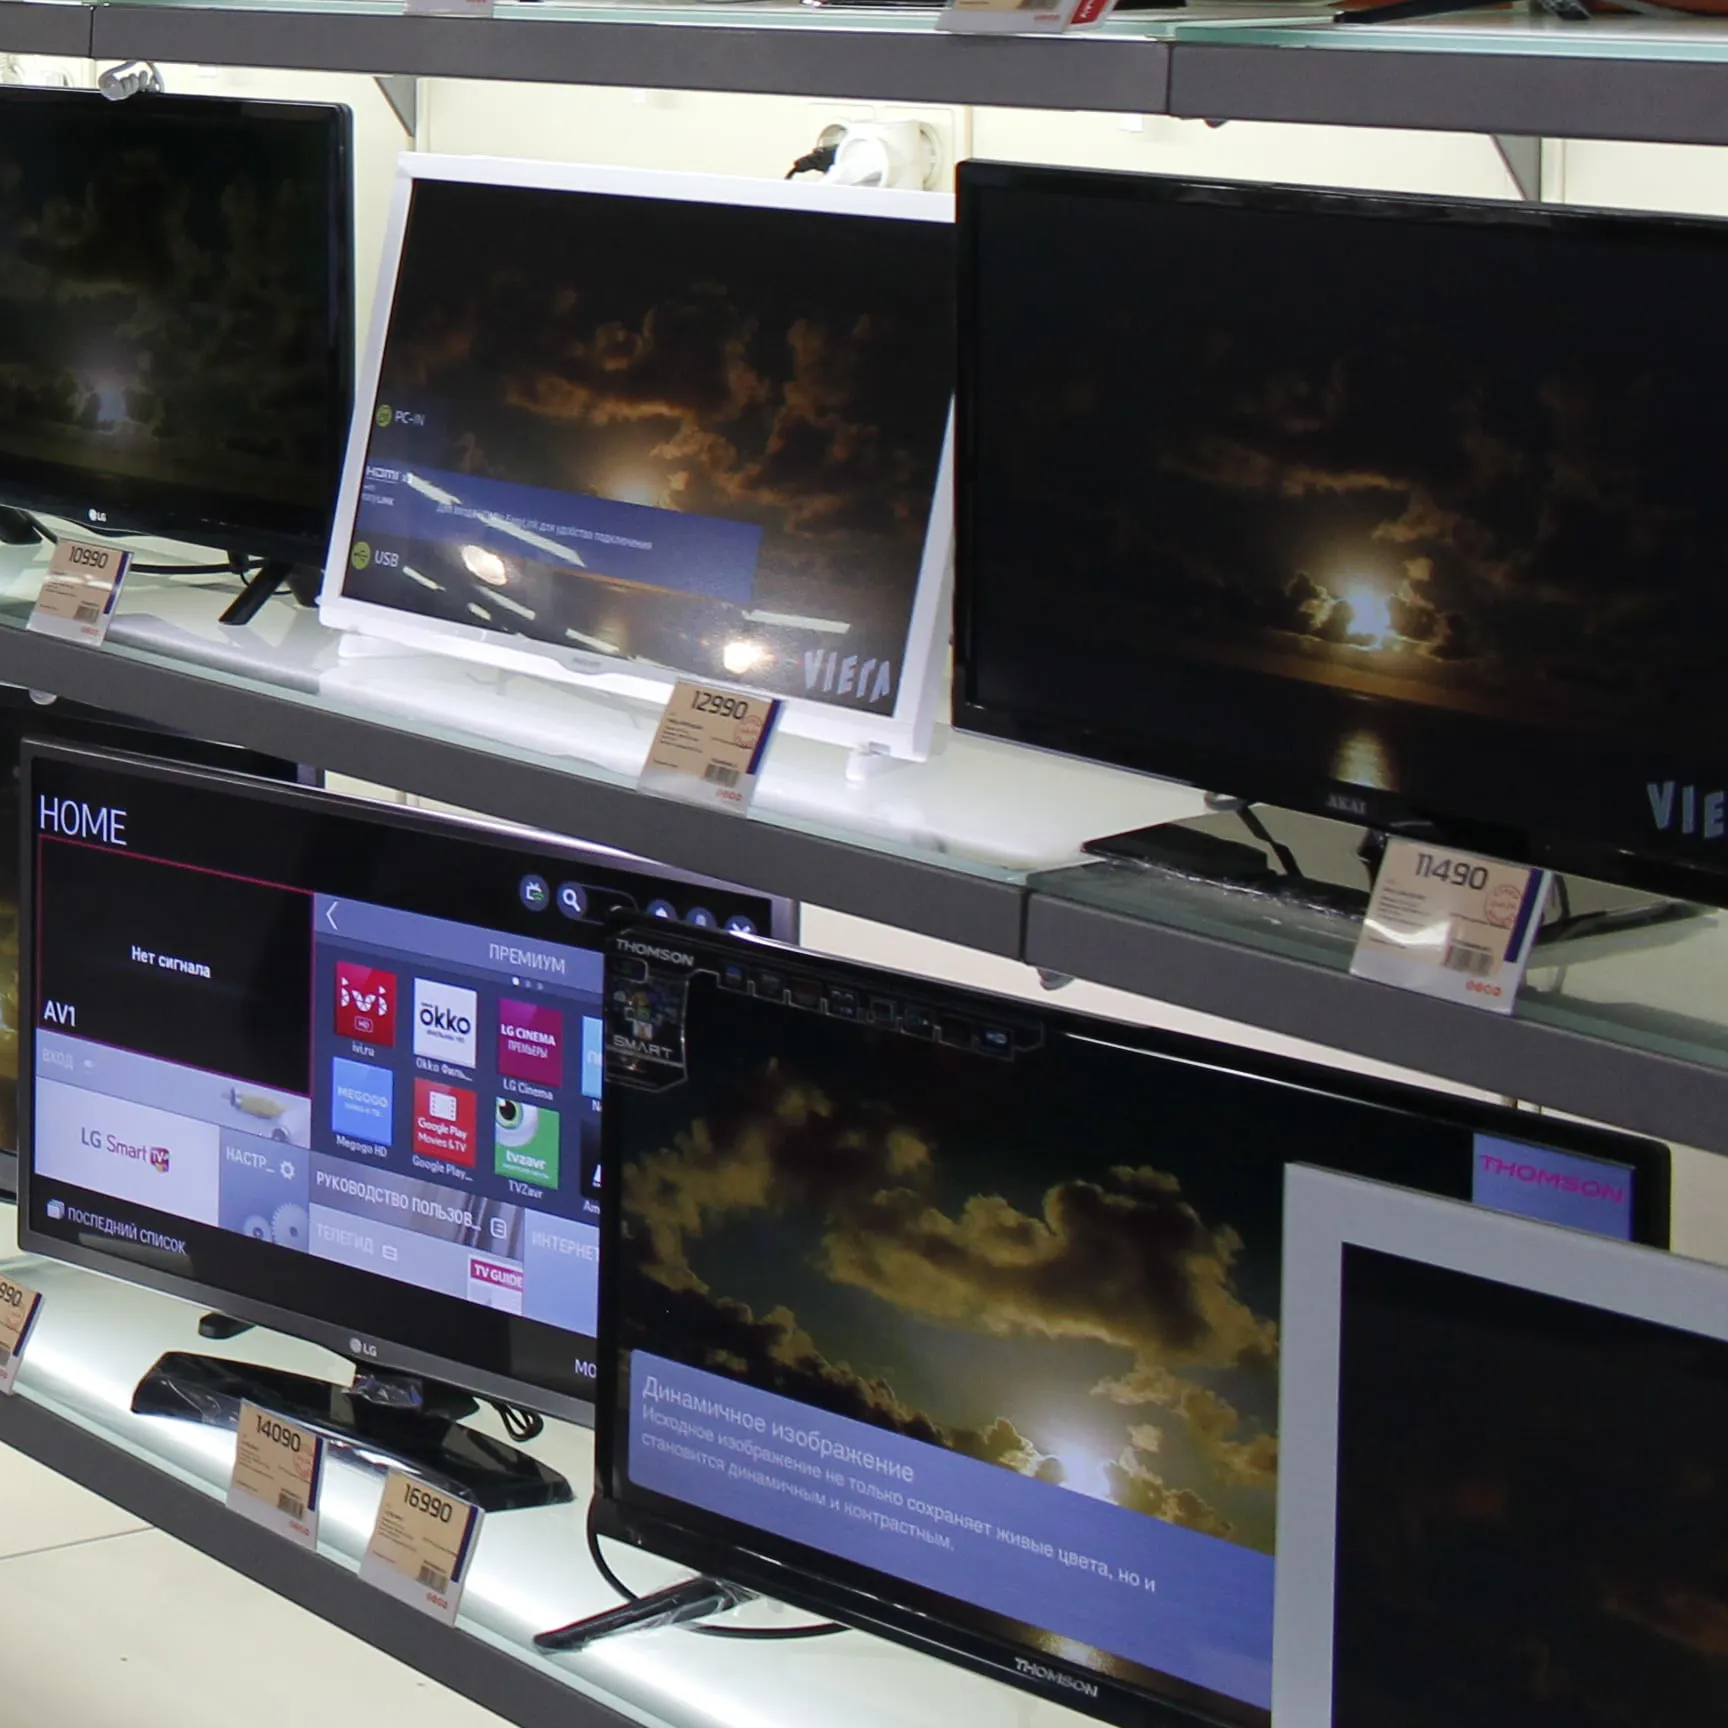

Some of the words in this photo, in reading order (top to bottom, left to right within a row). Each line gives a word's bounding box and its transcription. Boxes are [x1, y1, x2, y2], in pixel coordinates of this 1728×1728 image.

[69, 545, 109, 569] 10990
[375, 550, 399, 568] USB
[691, 690, 748, 719] 12990
[39, 794, 128, 846] HOME
[1415, 852, 1489, 890] 11490
[131, 944, 155, 965] Нет
[158, 953, 211, 979] сигнала
[489, 942, 566, 974] ПРЕМИУМ
[616, 938, 696, 967] THOMSON
[44, 999, 76, 1027] AV1
[341, 976, 388, 1016] ivi
[501, 1024, 514, 1038] LG
[516, 1027, 556, 1046] CINEMA
[613, 1034, 672, 1060] SMART
[42, 1048, 74, 1071] ВХОД
[503, 1078, 516, 1092] LG
[518, 1082, 554, 1101] Cinema
[80, 1125, 102, 1150] LG
[106, 1133, 148, 1162] Smart
[336, 1134, 373, 1156] Megogo
[374, 1145, 388, 1158] HD
[412, 1154, 444, 1174] Google
[1481, 1154, 1626, 1204] THOMSON
[316, 1171, 409, 1210] РУКОВОДСТВО
[67, 1202, 137, 1243] ПОСЛЕДНИЙ
[139, 1223, 187, 1256] СПИСОК
[316, 1222, 374, 1256] ТЕЛЕГИД
[474, 1263, 491, 1278] TV
[491, 1268, 523, 1288] GUIDE
[362, 1342, 377, 1357] LG
[256, 1415, 302, 1453] 14090
[642, 1375, 767, 1434] Динамичное
[772, 1421, 916, 1484] изображение
[404, 1483, 453, 1524] 16990
[641, 1432, 726, 1471] становится
[727, 1461, 827, 1506] динамичным
[829, 1497, 840, 1512] и
[844, 1502, 955, 1552] контрастным.
[642, 1404, 715, 1444] Исходное
[717, 1434, 822, 1479] изображение
[826, 1468, 845, 1487] не
[849, 1475, 903, 1506] только
[906, 1497, 993, 1538] сохраняет
[996, 1525, 1054, 1558] живые
[1058, 1547, 1114, 1581] цвета,
[1118, 1569, 1140, 1587] но
[1144, 1577, 1156, 1593] и
[1014, 1656, 1099, 1698] THOMSON
